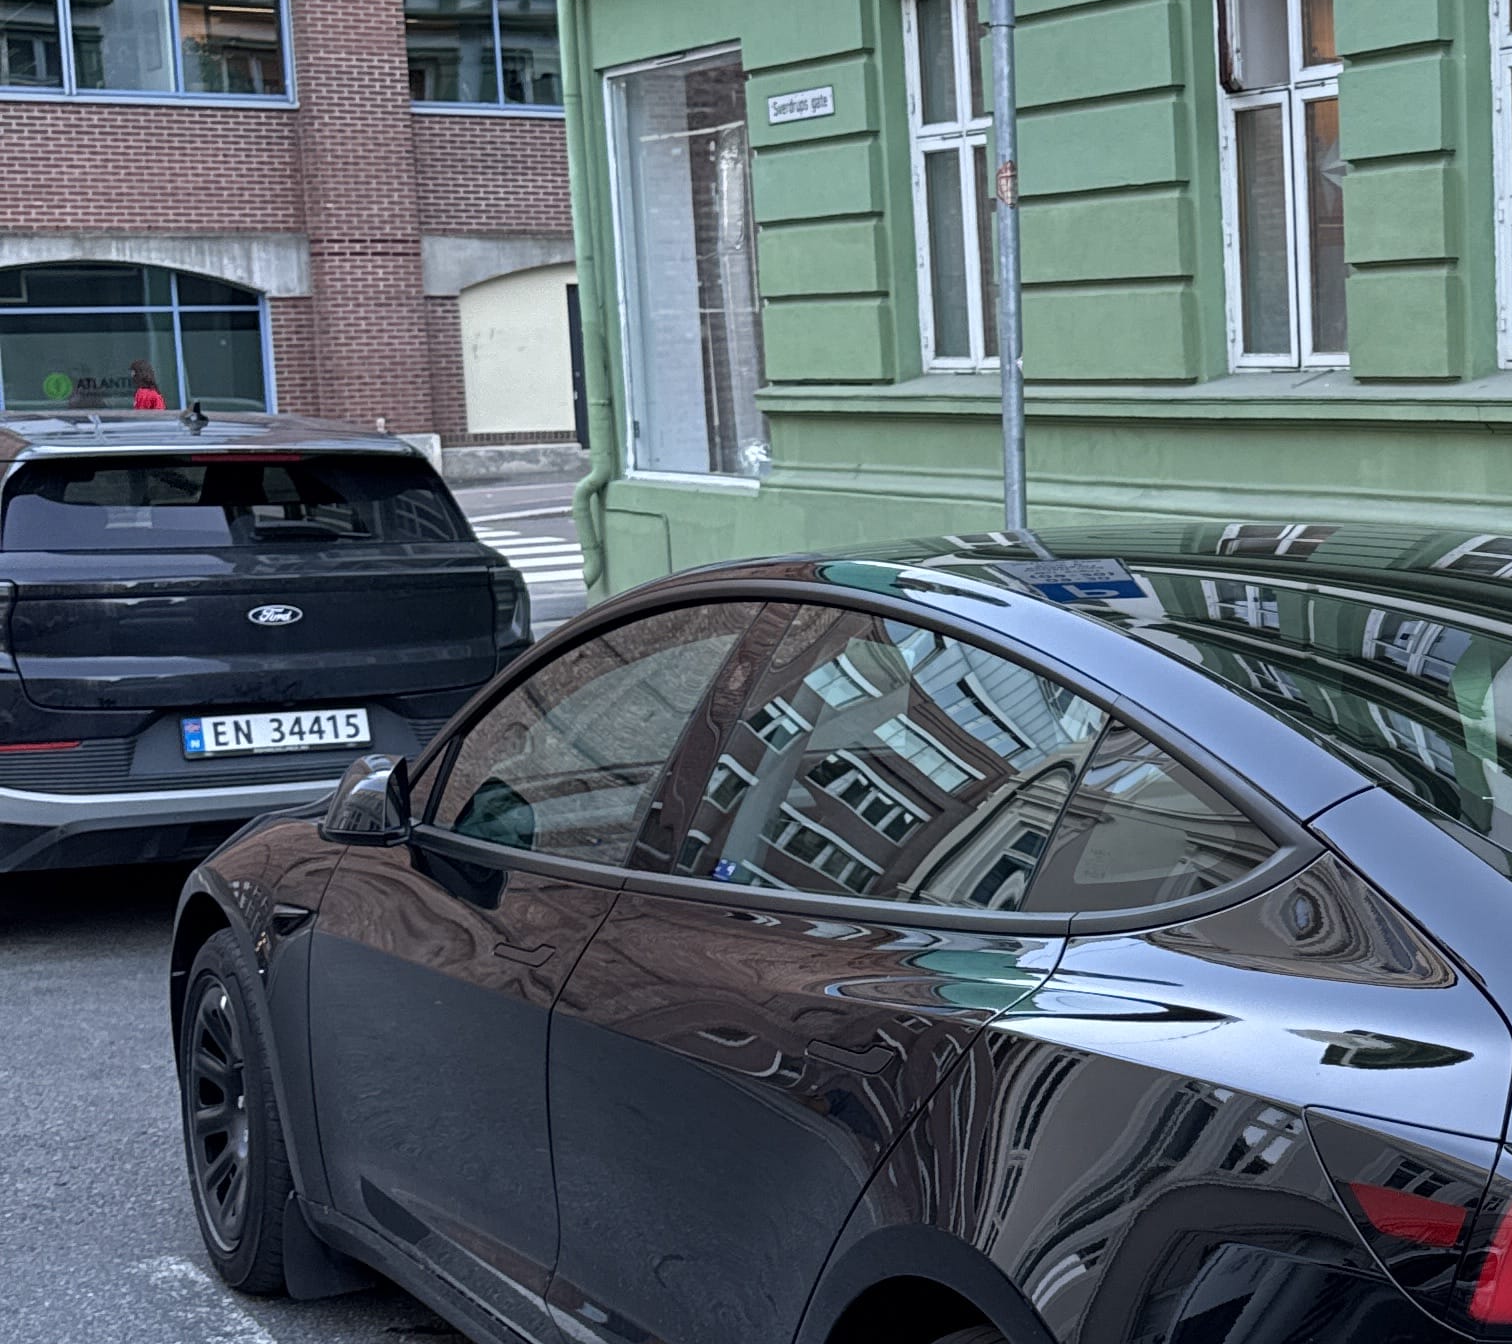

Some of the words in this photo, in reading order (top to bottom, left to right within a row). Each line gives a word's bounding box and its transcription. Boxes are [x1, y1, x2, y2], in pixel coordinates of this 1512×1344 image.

[811, 94, 828, 113] gate
[212, 719, 253, 747] EN
[269, 713, 360, 744] 34415
